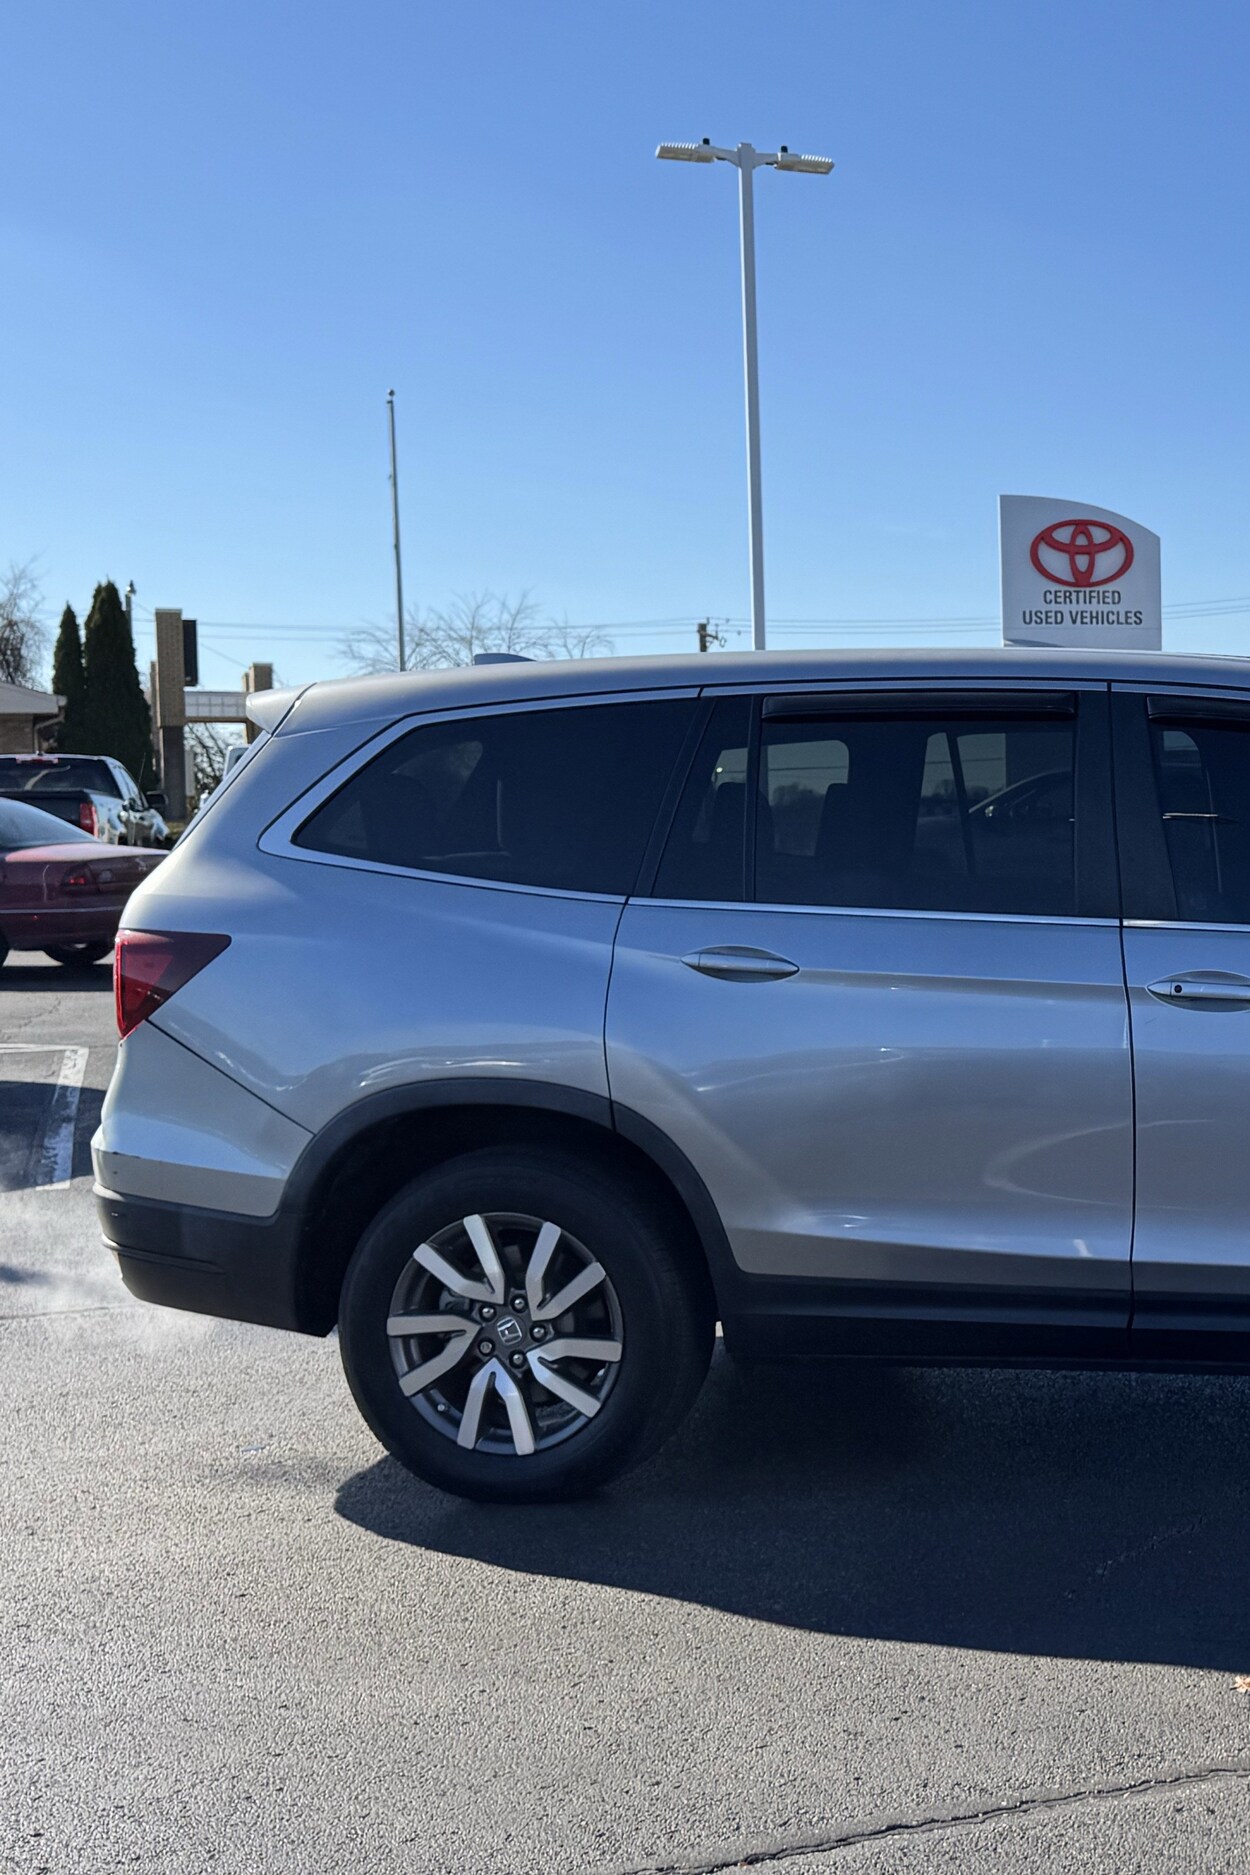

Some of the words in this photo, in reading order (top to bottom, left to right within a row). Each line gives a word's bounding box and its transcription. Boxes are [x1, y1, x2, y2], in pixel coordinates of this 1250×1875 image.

[1043, 590, 1121, 605] CERTIFIED
[1022, 610, 1064, 625] USED
[1069, 610, 1143, 626] VEHICLES
